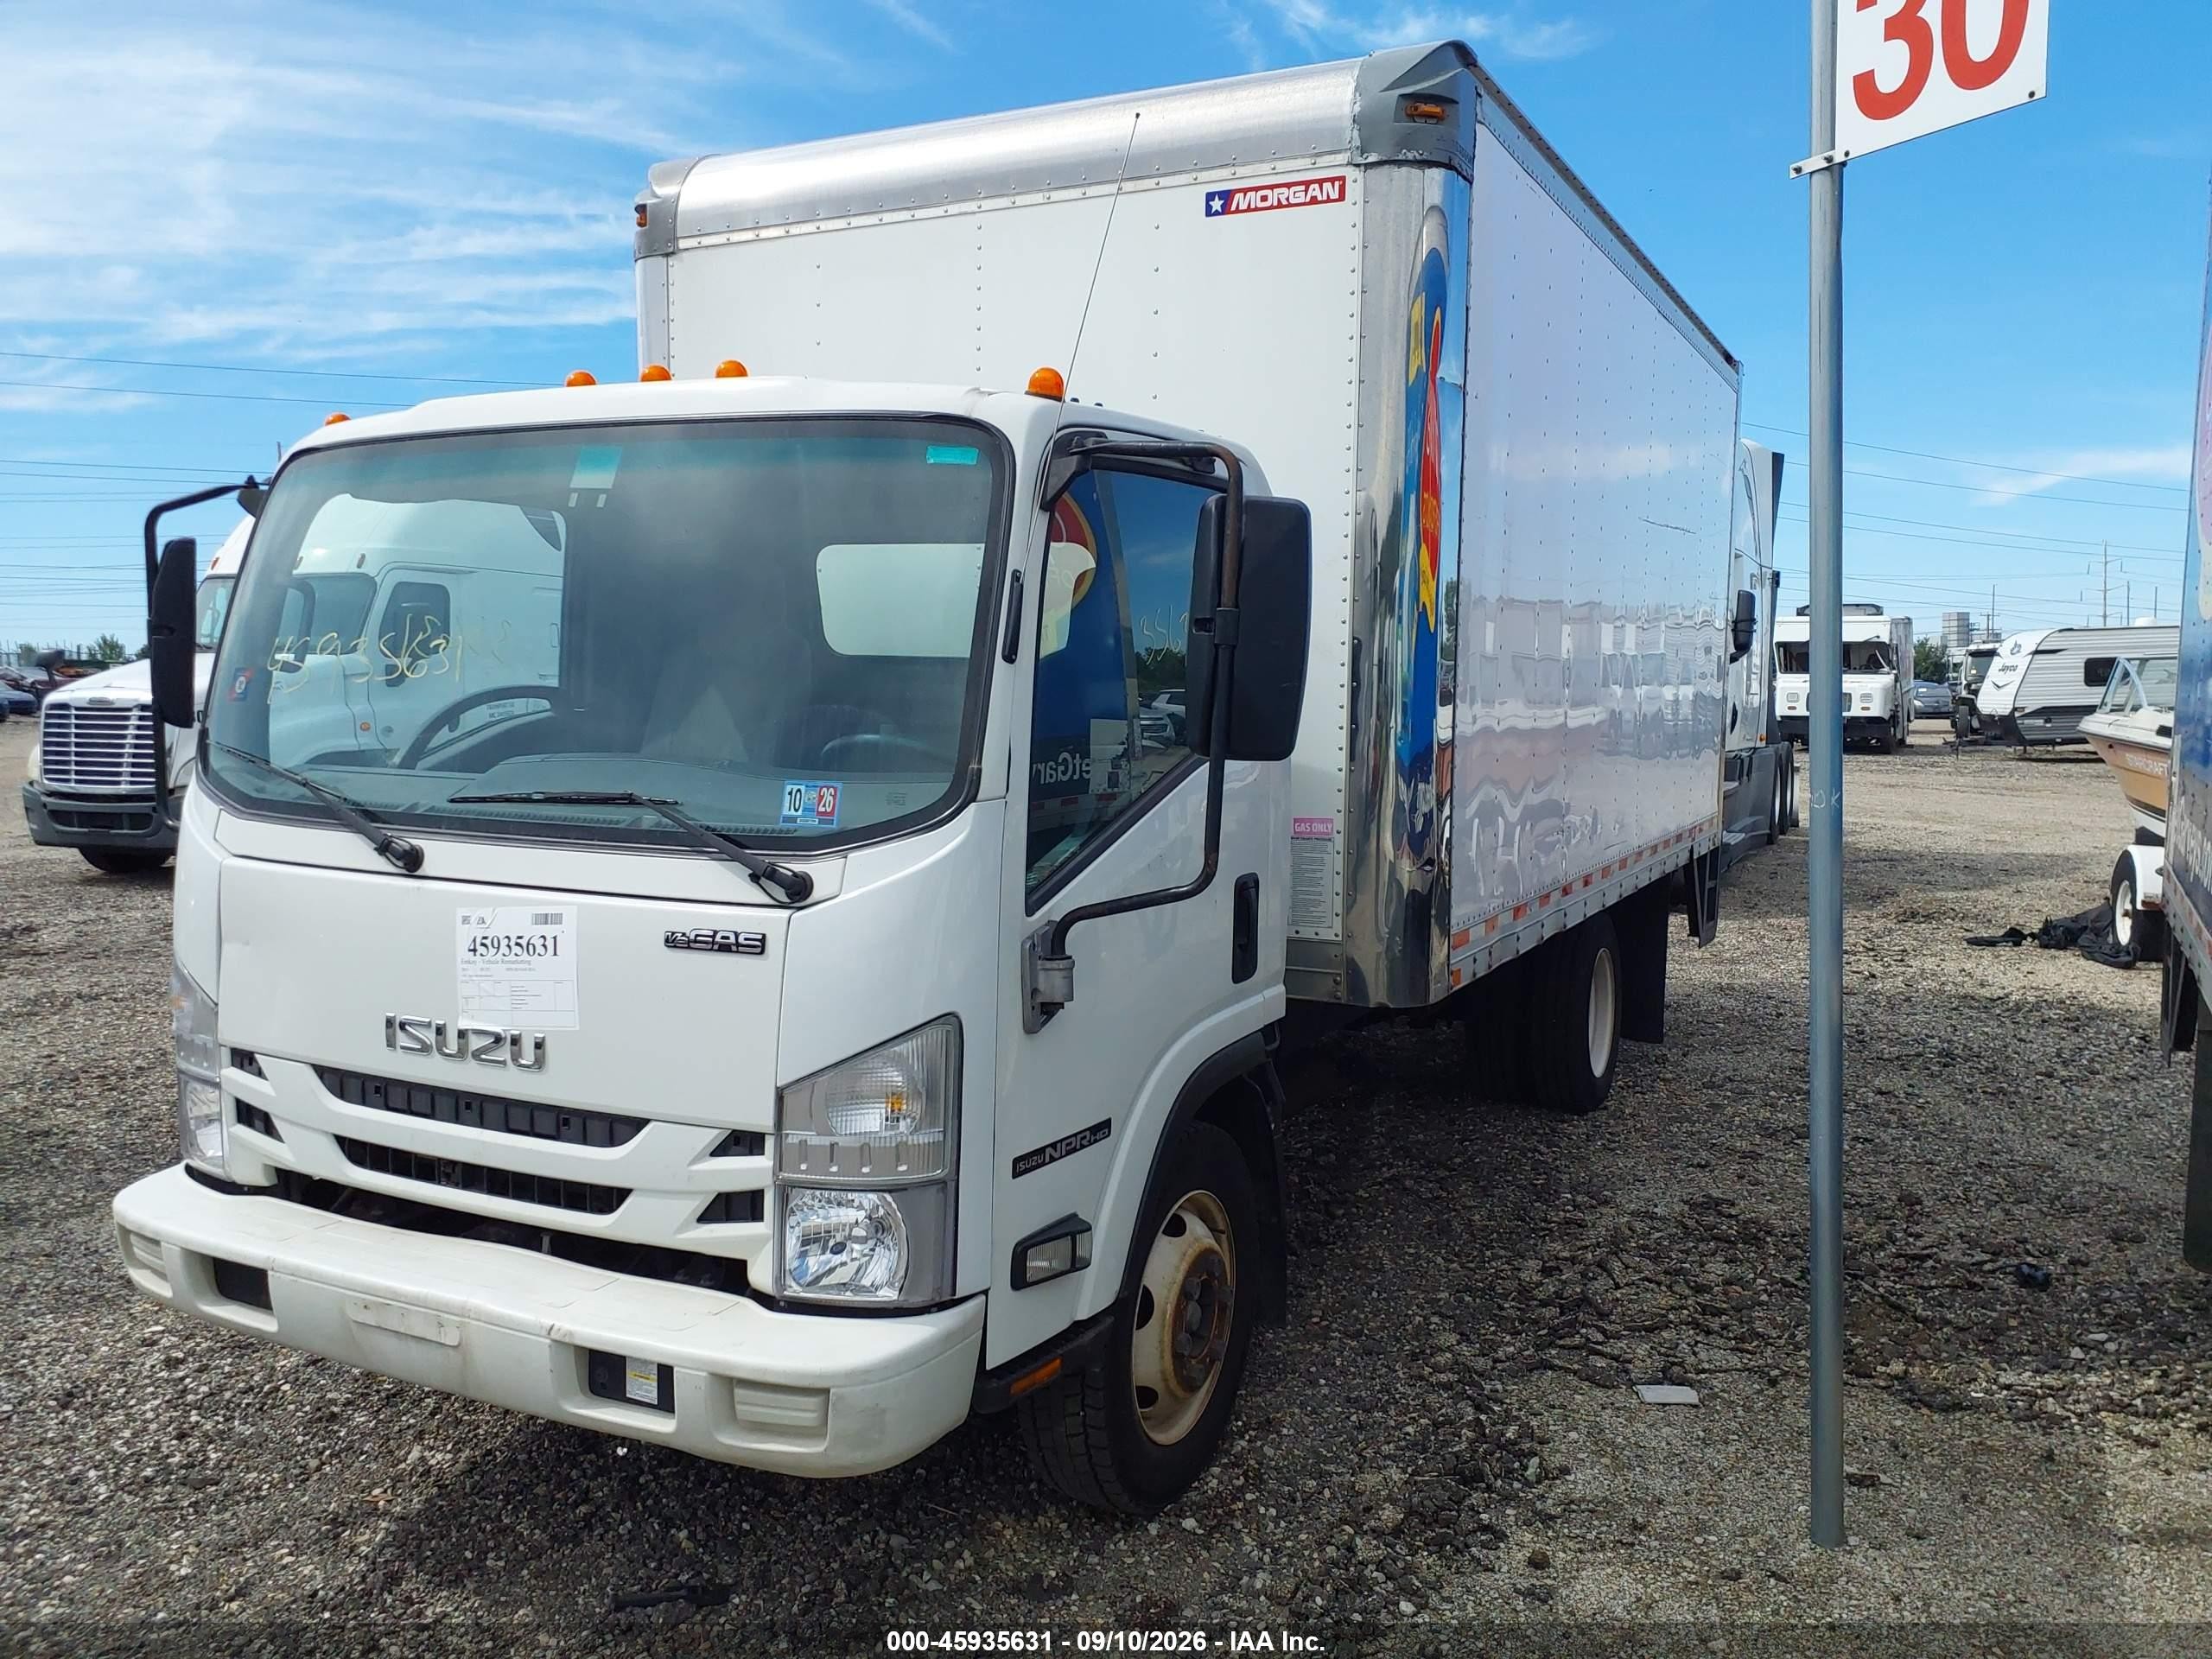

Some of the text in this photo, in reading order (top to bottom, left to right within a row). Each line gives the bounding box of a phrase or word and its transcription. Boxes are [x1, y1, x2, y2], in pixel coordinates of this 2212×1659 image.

[1853, 0, 2030, 121] 30
[1230, 181, 1340, 212] MORGAN
[787, 787, 835, 813] 10 26
[1294, 822, 1333, 832] GAS ONLY
[467, 934, 560, 957] 45935631
[385, 1012, 546, 1072] ISUZU
[1016, 1153, 1045, 1173] ISUZU
[1045, 1130, 1090, 1163] NPR
